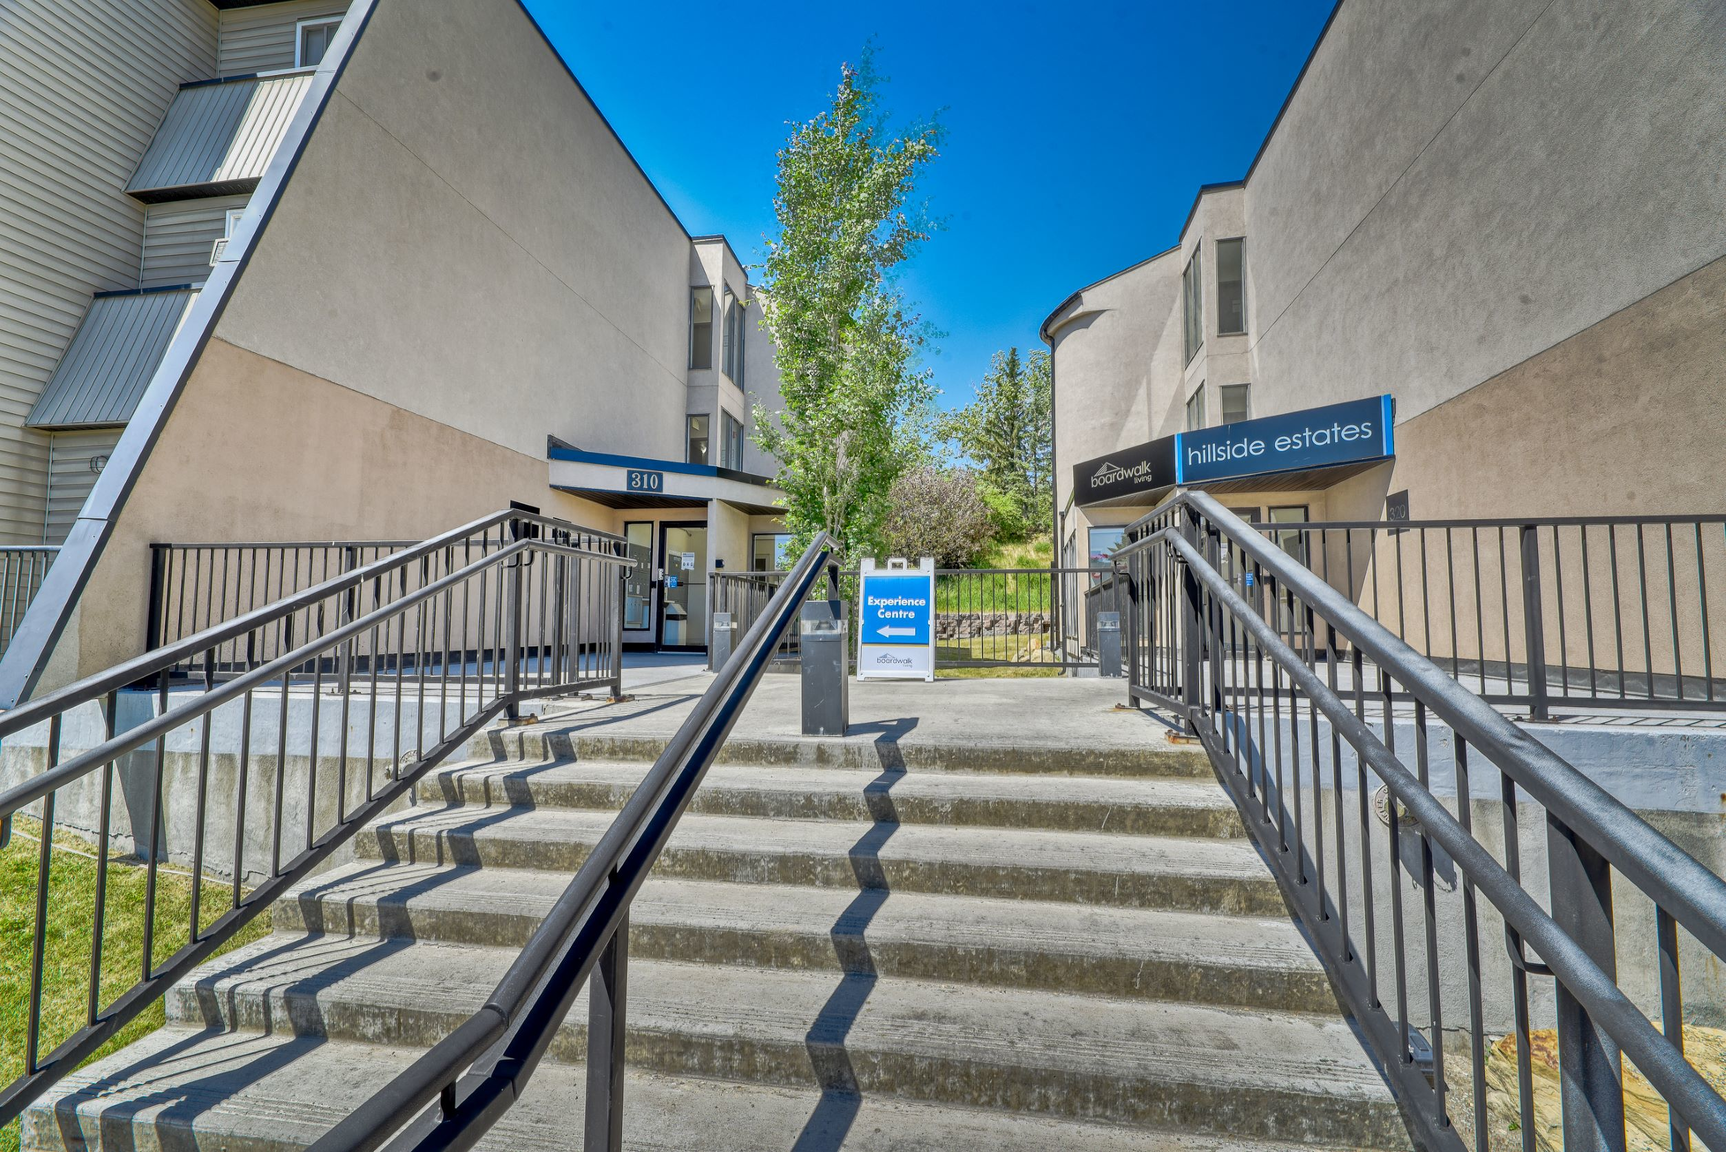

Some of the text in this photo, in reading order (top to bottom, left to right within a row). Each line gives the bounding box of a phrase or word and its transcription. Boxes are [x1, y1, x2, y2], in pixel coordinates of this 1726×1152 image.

[1188, 421, 1373, 466] hillside estates
[631, 472, 659, 489] 310
[1090, 460, 1152, 488] boardwalk
[1133, 474, 1153, 485] living
[1389, 504, 1406, 521] 320
[867, 596, 926, 608] Experience
[877, 609, 916, 619] Centre
